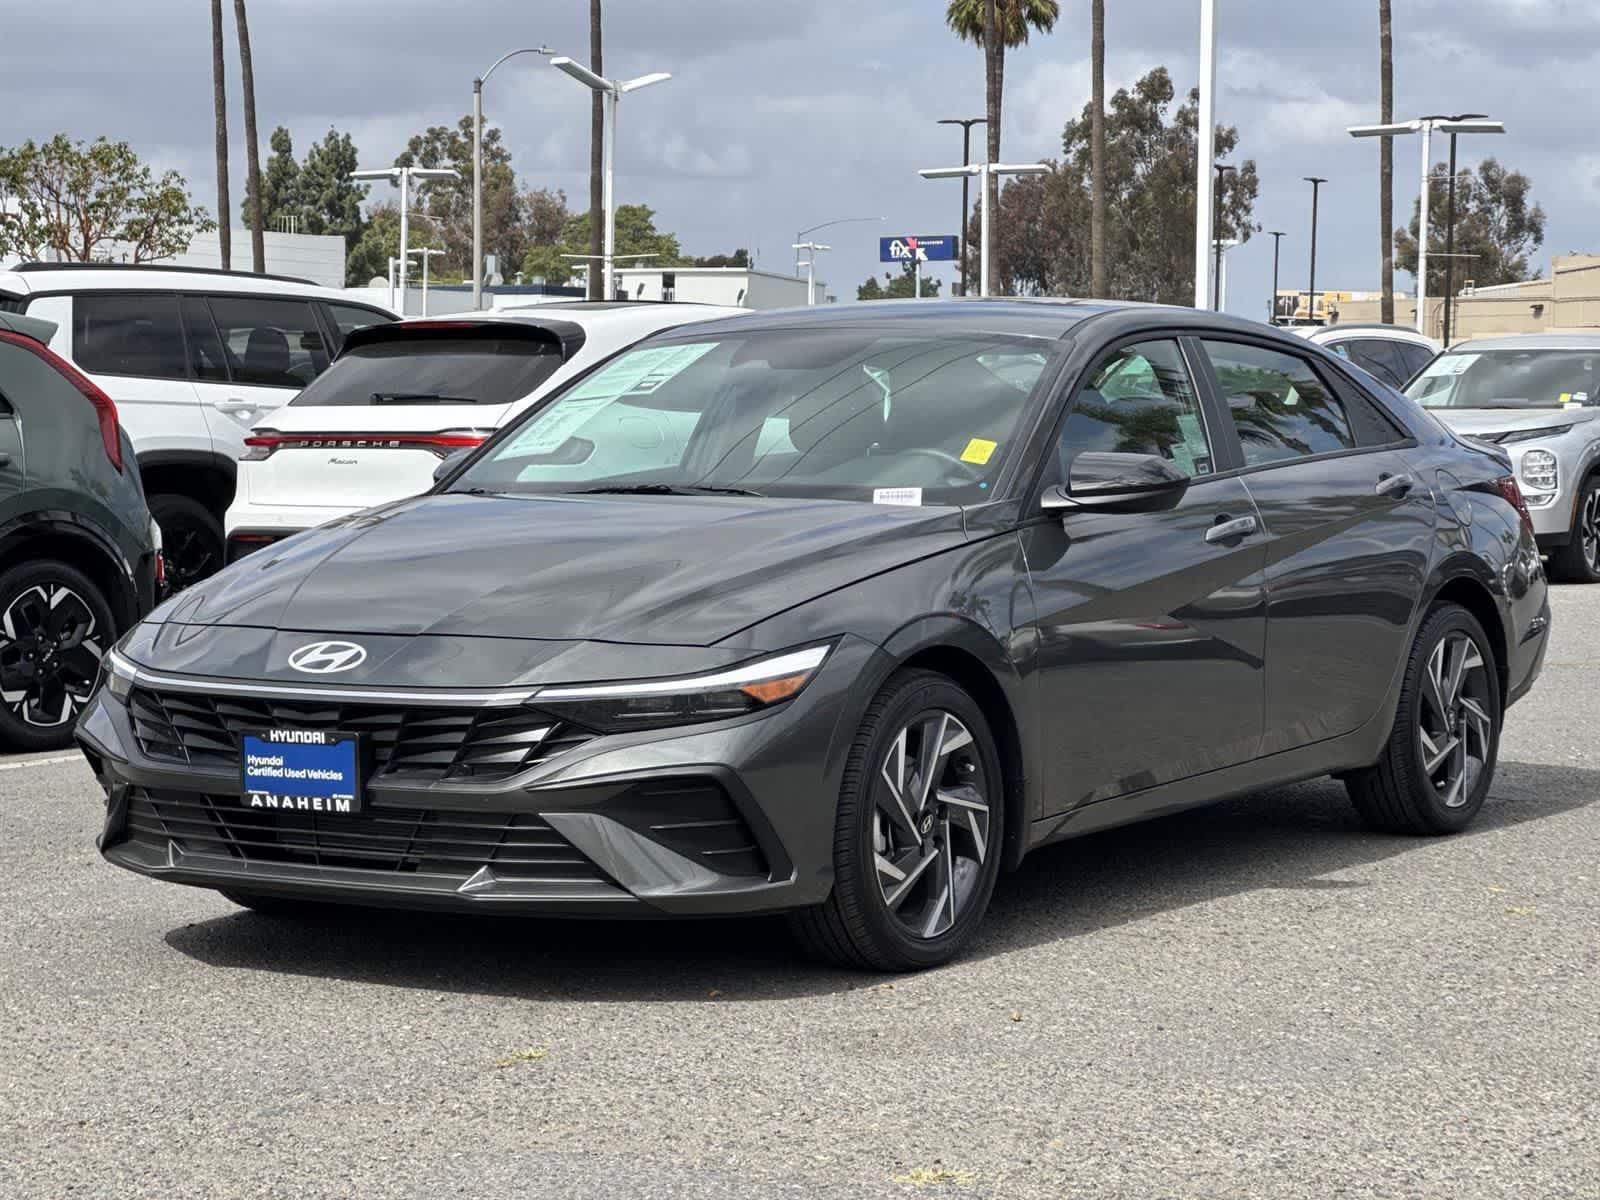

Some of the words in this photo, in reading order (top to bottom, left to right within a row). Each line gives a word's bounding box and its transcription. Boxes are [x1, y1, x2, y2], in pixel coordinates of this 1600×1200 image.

[300, 440, 400, 448] PORSCHE
[270, 730, 326, 745] HYUNDAI
[247, 755, 284, 767] Hyundai
[247, 766, 283, 778] Certified
[284, 769, 306, 779] Used
[307, 769, 344, 781] Vehicles
[250, 794, 351, 812] ANAHEIM
